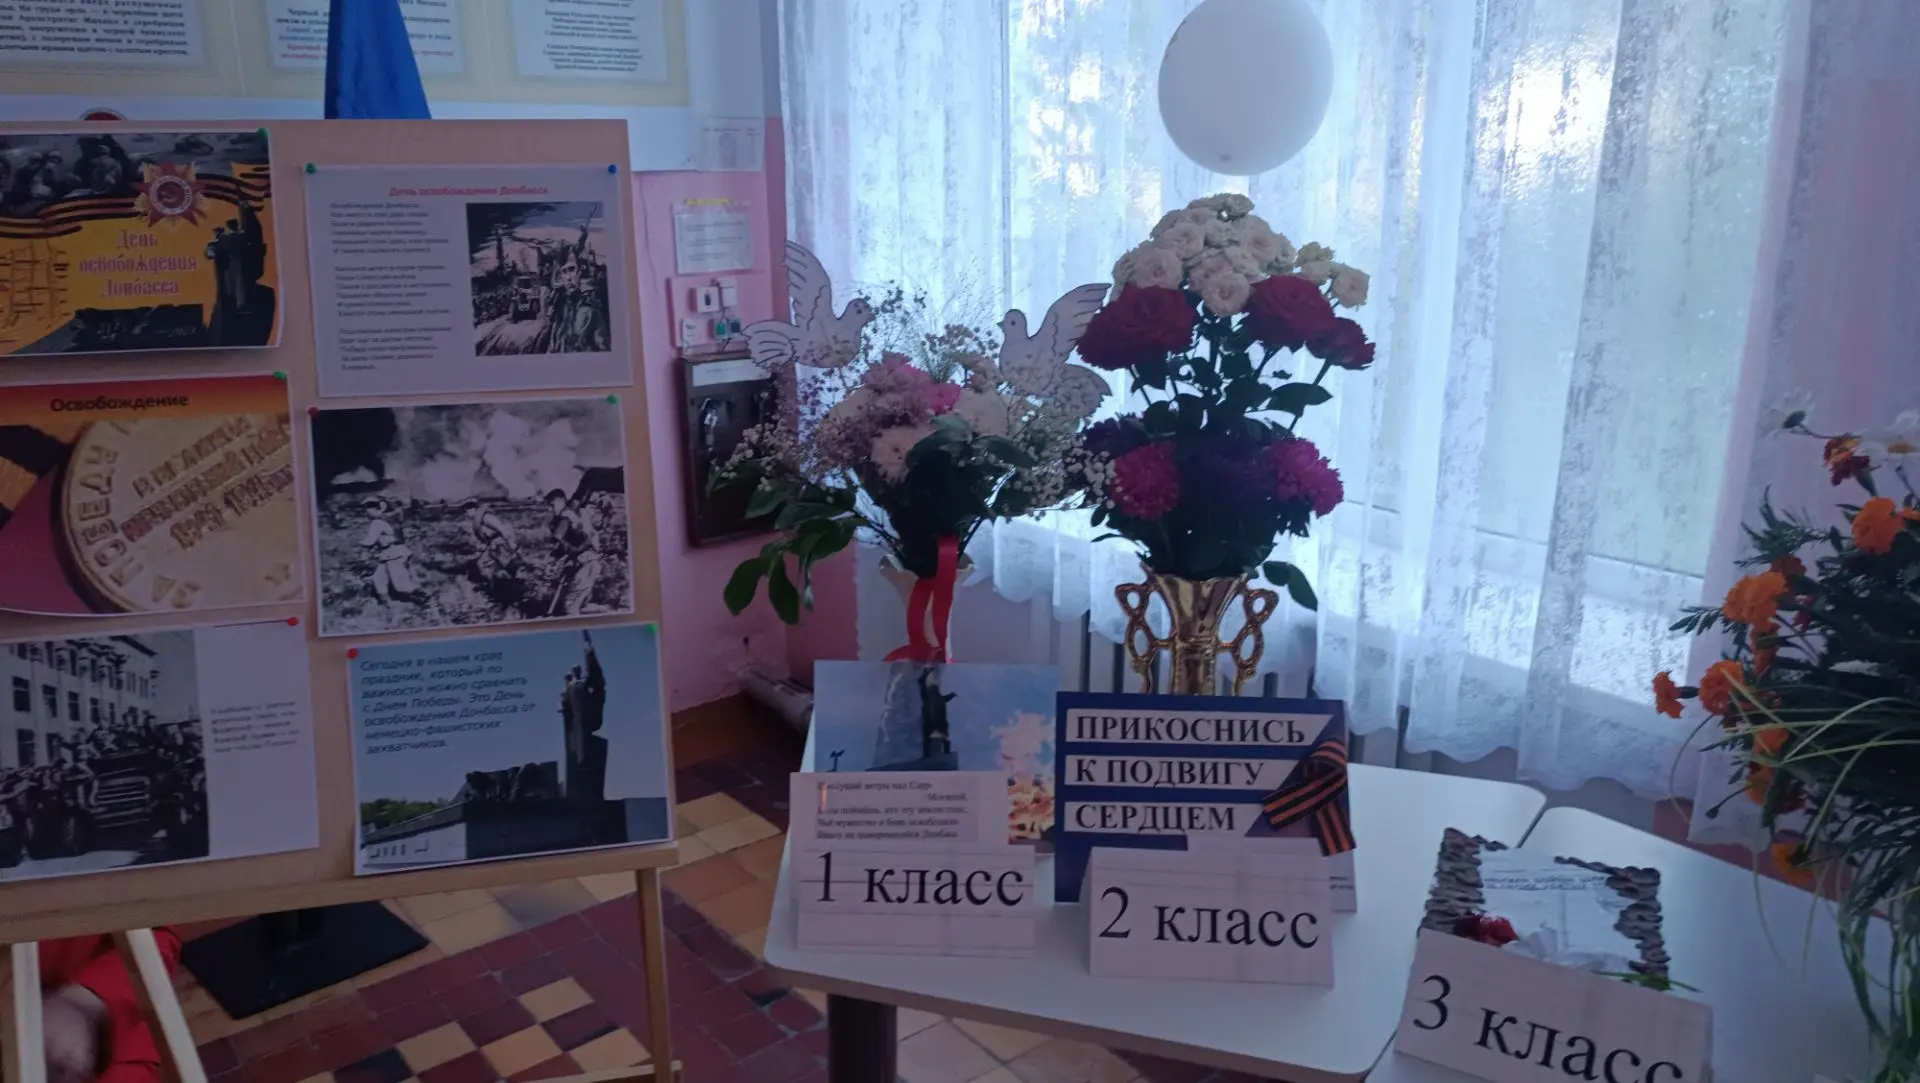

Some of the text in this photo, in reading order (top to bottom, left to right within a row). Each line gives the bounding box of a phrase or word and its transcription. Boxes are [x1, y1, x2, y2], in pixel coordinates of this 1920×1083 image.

[117, 229, 159, 248] День
[80, 253, 197, 275] освобождения
[102, 278, 179, 297] Донбасса
[51, 395, 189, 412] Освобождение
[360, 659, 413, 671] Сегодня
[428, 655, 471, 666] нашем
[430, 665, 484, 680] который
[487, 666, 503, 674] по
[427, 682, 468, 694] можно
[471, 677, 529, 691] сравнить
[469, 692, 491, 704] Это
[493, 690, 526, 703] День
[364, 703, 536, 727] освобождения Донбасса от
[365, 721, 503, 740] немецко-фашистских
[1075, 715, 1306, 744] ПРИКОСНИСЬ
[1075, 758, 1265, 788] К ПОДВИГУ
[1075, 803, 1237, 834] СЕРДЦЕМ
[817, 851, 1025, 906] 1 класс
[1098, 886, 1320, 950] 2 класс
[1412, 974, 1452, 1031] 3
